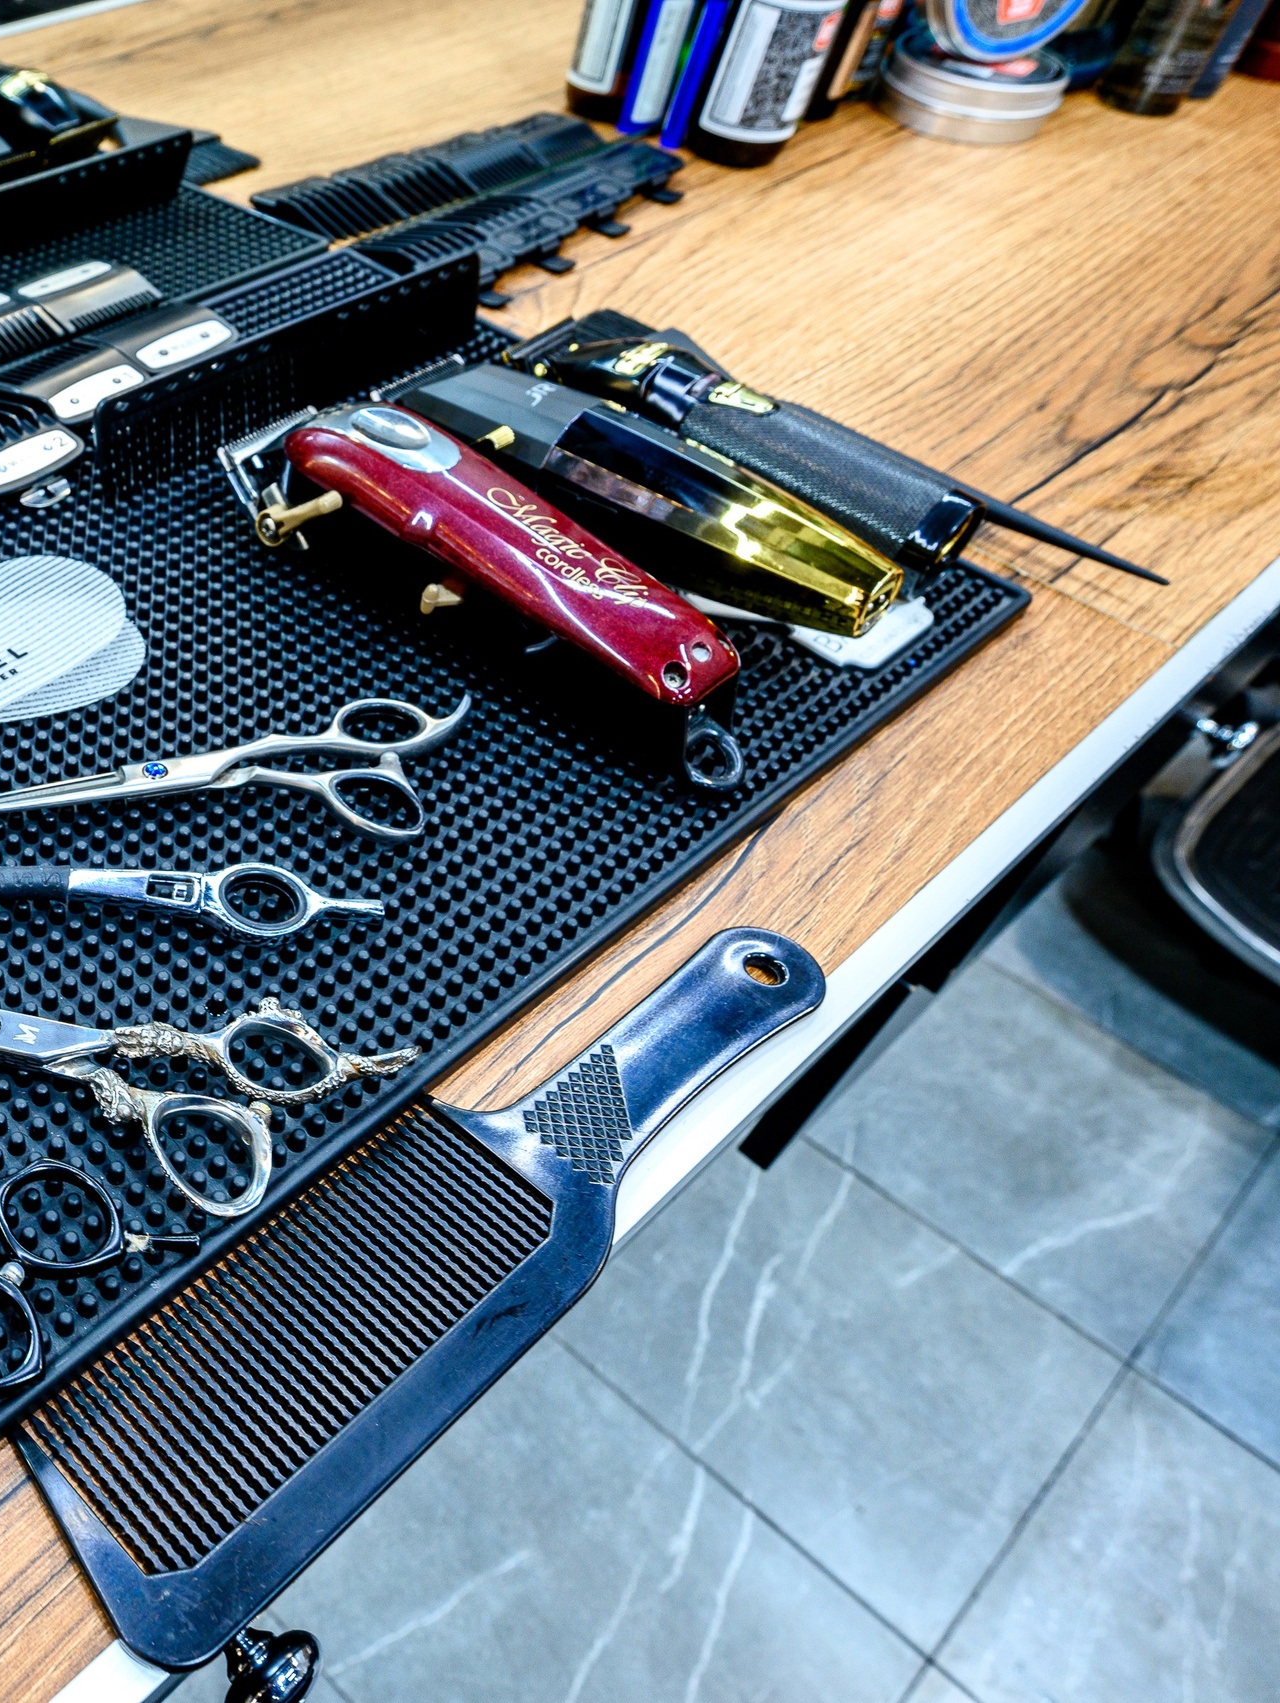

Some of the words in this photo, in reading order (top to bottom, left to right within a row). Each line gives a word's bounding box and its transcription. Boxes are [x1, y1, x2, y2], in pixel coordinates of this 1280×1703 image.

[486, 487, 593, 560] Magic
[594, 557, 650, 608] Clip
[535, 548, 604, 600] cordless
